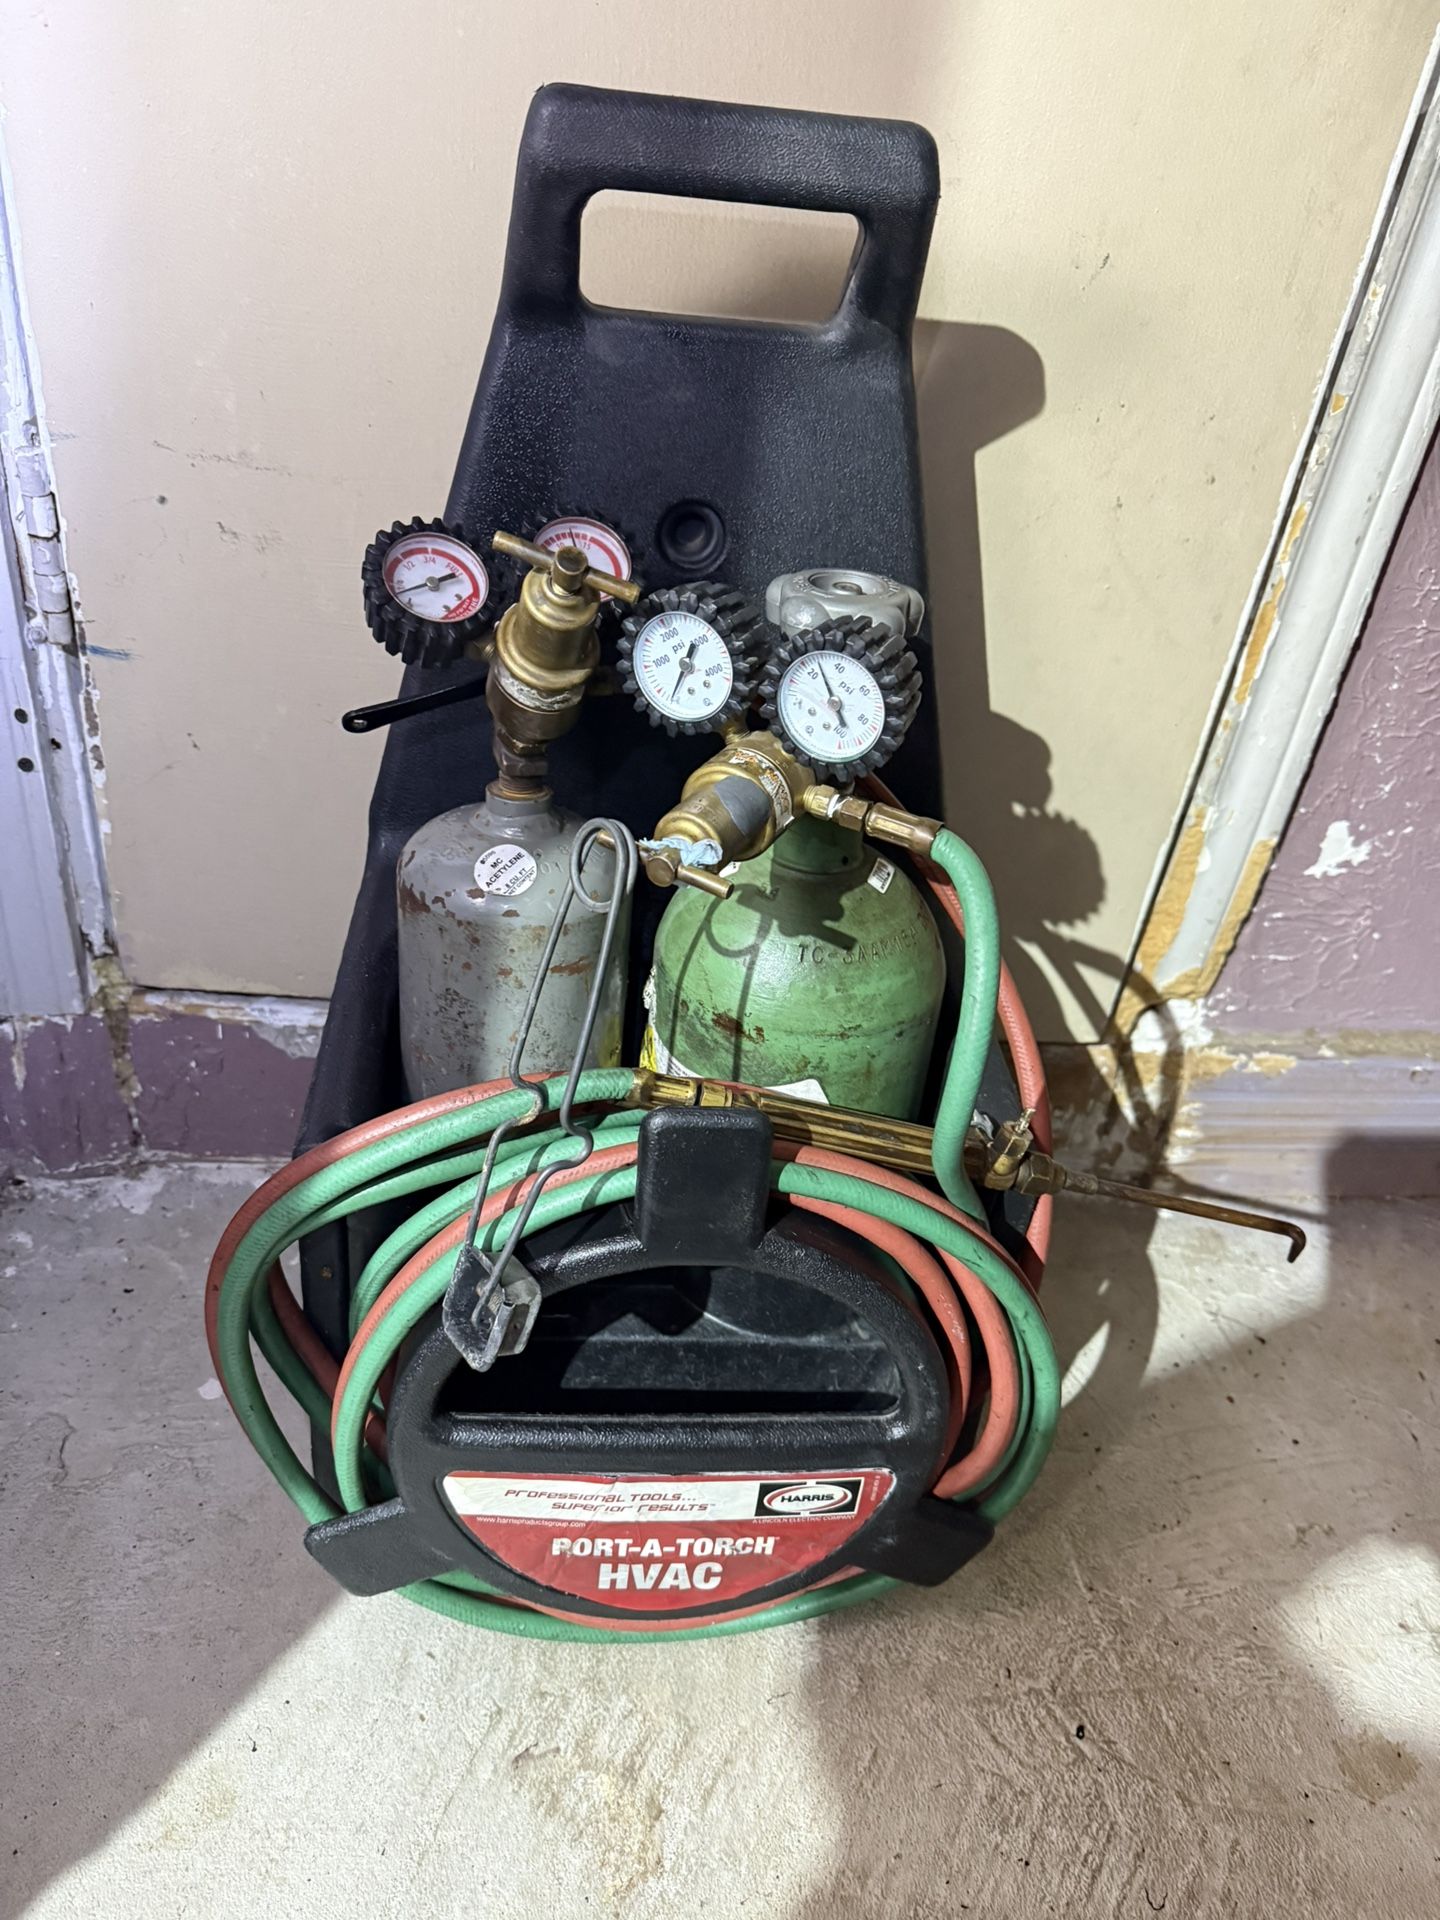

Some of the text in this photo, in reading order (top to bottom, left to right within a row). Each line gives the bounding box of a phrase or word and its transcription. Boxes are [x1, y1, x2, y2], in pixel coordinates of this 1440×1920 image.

[403, 560, 416, 571] 1/2
[423, 555, 437, 565] 3/4
[660, 626, 679, 642] 2000
[672, 639, 685, 654] psi
[653, 654, 670, 668] 1000
[834, 662, 845, 674] 40
[704, 663, 723, 677] 4000
[807, 668, 819, 680] 20
[838, 681, 855, 695] psi
[859, 684, 871, 696] 60
[857, 713, 869, 725] 80
[833, 725, 847, 739] 100
[485, 852, 525, 888] ACETYLENE
[490, 857, 503, 869] MC
[517, 869, 536, 888] CONTENT
[780, 1493, 835, 1503] HARRIS
[551, 1536, 775, 1557] PORT-A-TORCH
[598, 1562, 723, 1590] HVAC
